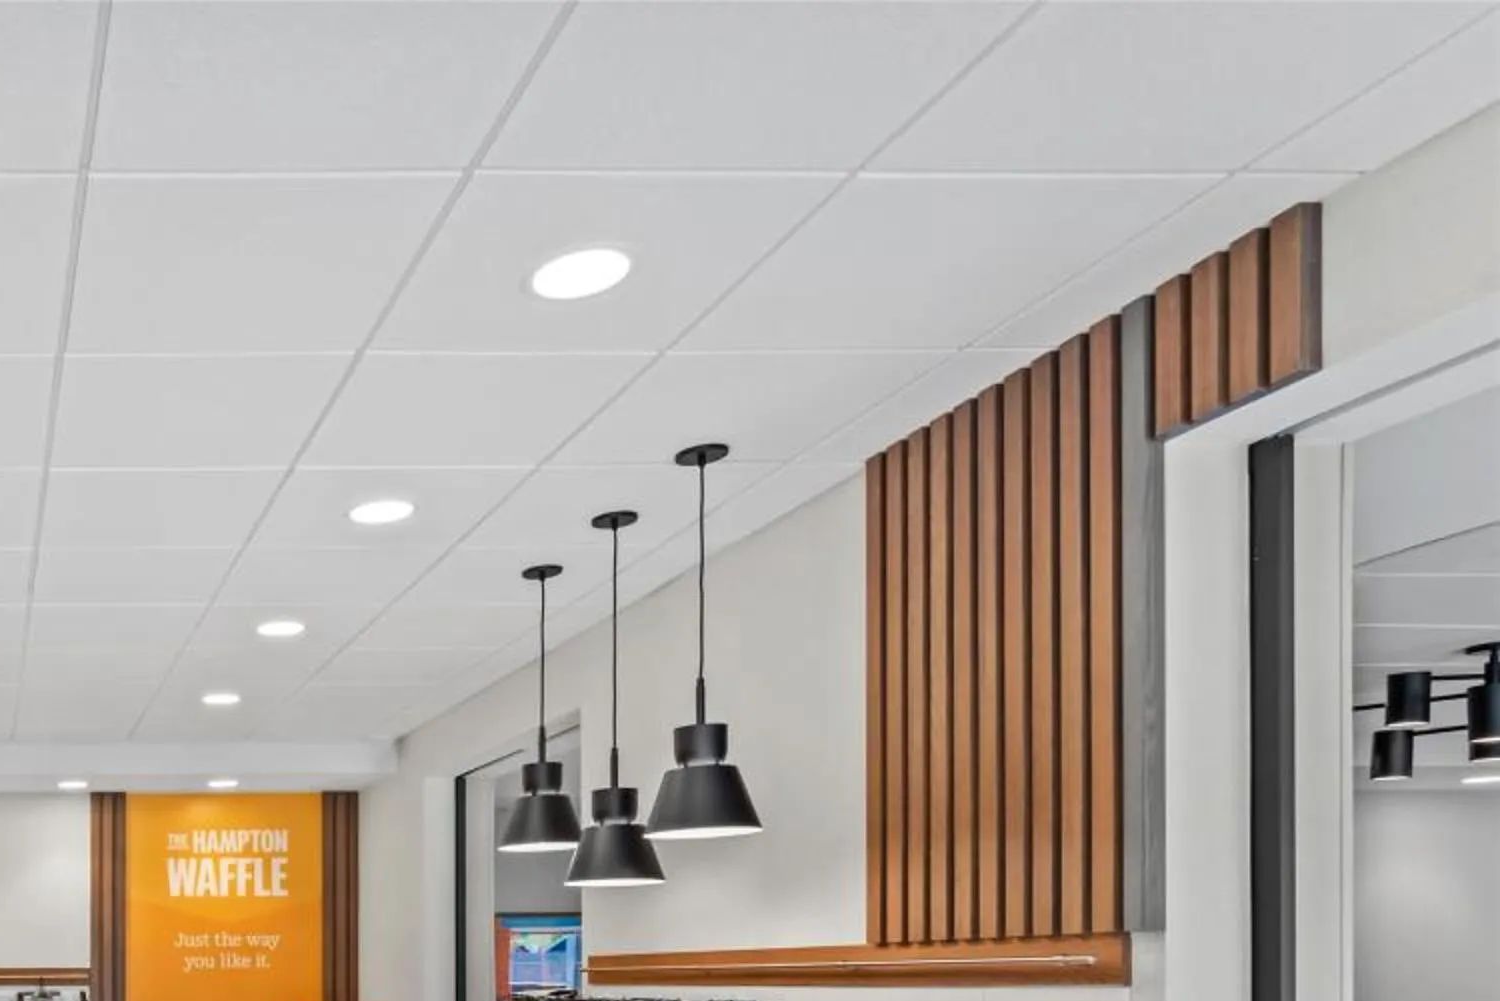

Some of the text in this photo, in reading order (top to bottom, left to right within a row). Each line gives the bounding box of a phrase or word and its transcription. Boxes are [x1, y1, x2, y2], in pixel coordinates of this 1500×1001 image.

[167, 828, 290, 854] THE HAMPTON
[166, 856, 290, 897] WAFFLE
[173, 930, 281, 951] Just the way
[183, 952, 272, 974] you like it.
